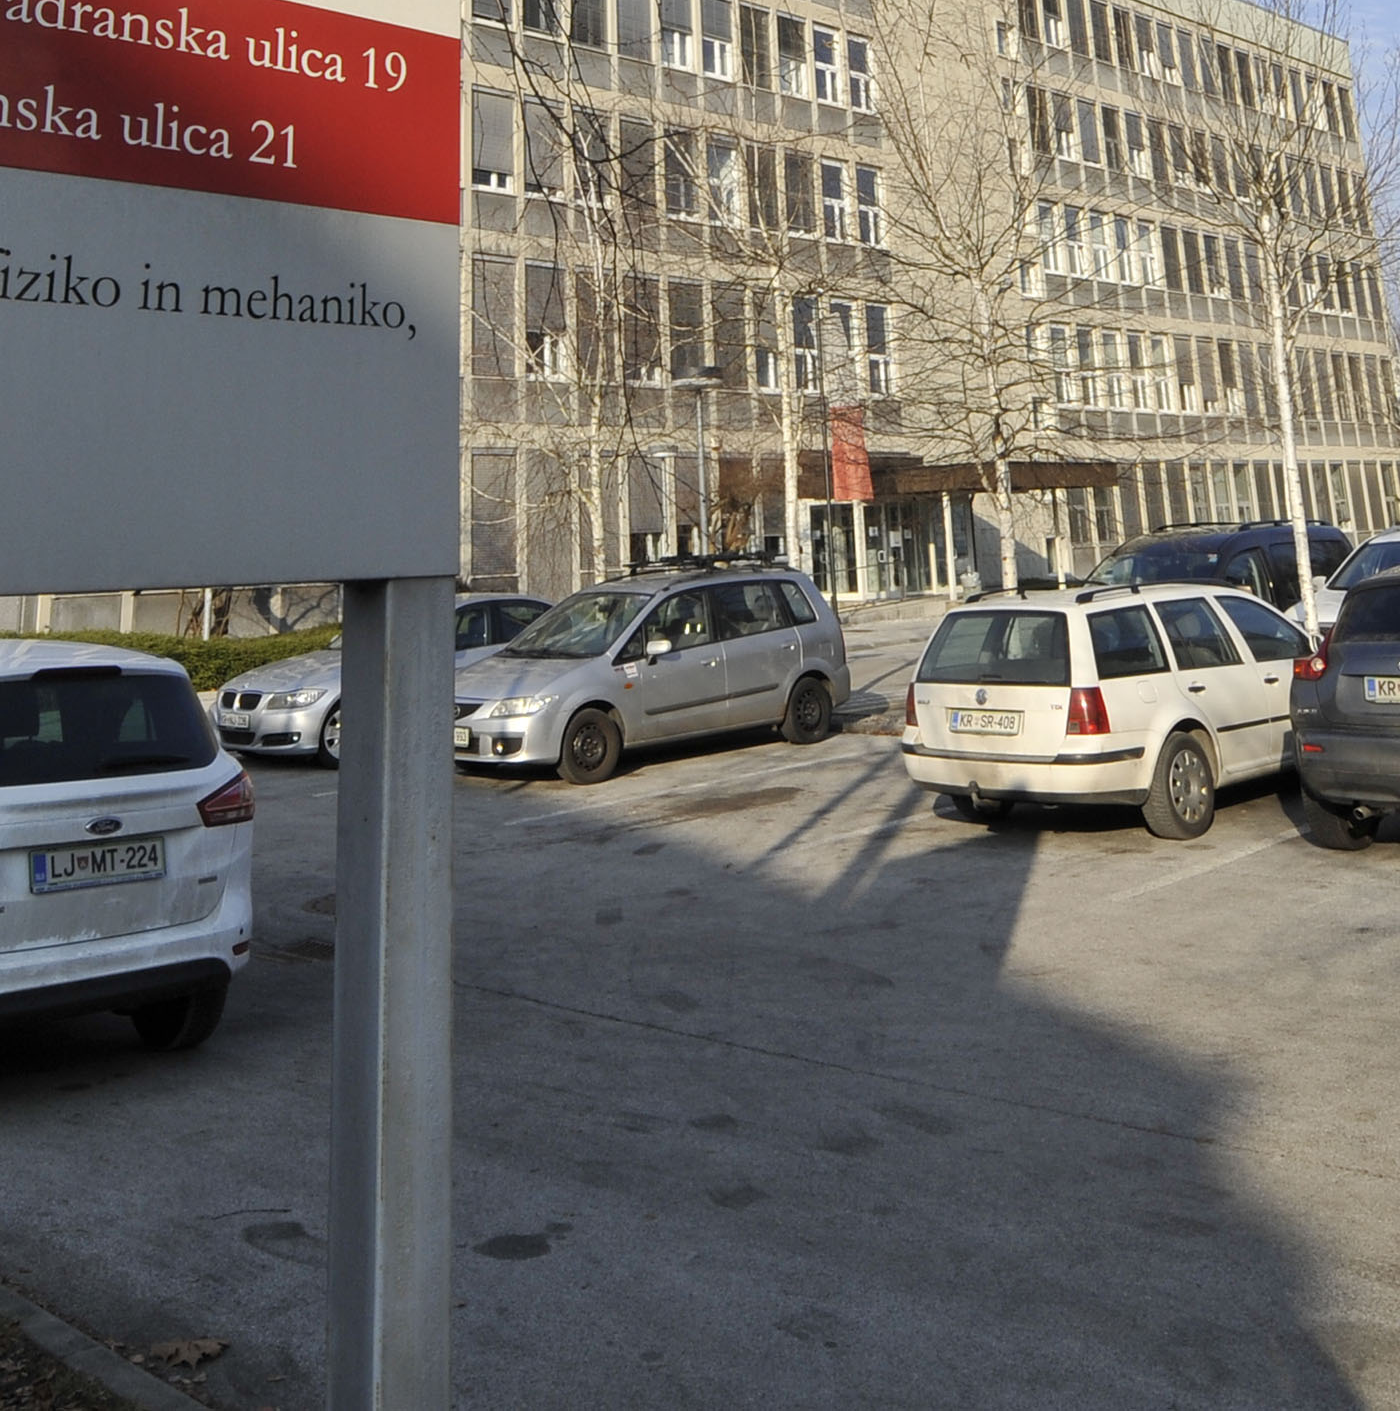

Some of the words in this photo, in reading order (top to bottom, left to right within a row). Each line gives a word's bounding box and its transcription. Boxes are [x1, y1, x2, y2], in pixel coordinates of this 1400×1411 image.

[247, 28, 345, 82] ulica
[364, 48, 406, 91] 19
[120, 102, 233, 159] ulica
[249, 120, 296, 167] 21
[138, 263, 182, 312] in
[200, 275, 416, 340] mehaniko,
[1377, 680, 1397, 697] KR
[959, 713, 973, 728] KR
[50, 852, 76, 879] LJ
[90, 843, 159, 874] MT-224
